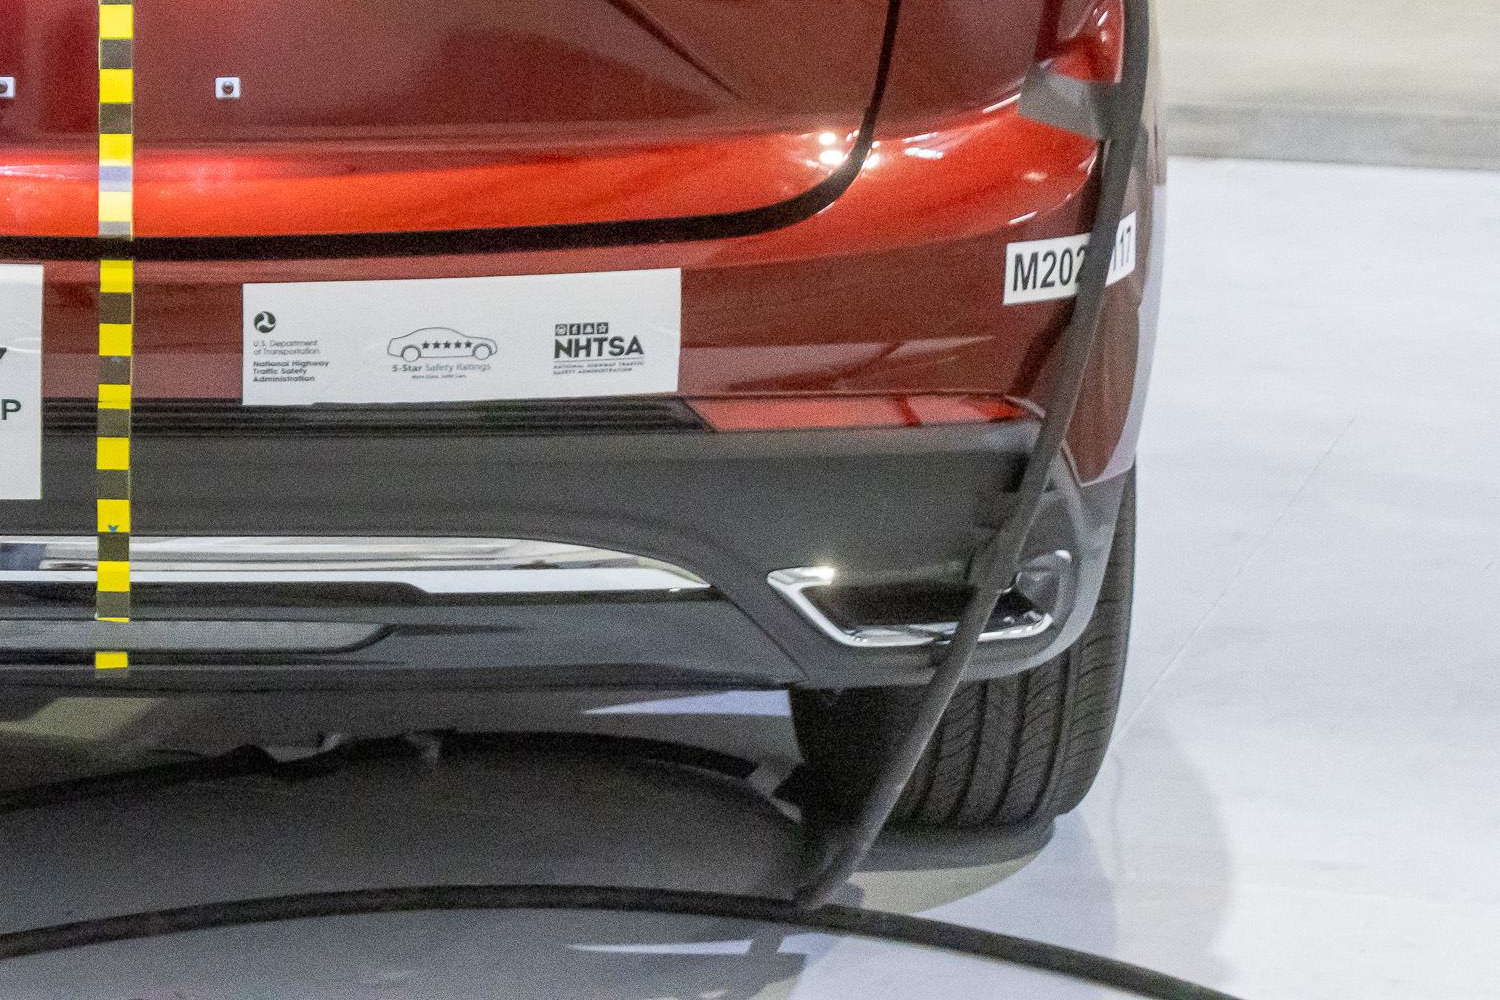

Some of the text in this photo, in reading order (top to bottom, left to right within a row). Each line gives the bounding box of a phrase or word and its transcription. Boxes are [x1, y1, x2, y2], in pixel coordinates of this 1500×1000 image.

[270, 340, 318, 348] Department
[554, 335, 644, 358] NHTSA
[392, 363, 491, 372] 5-Star Safety Ratings
